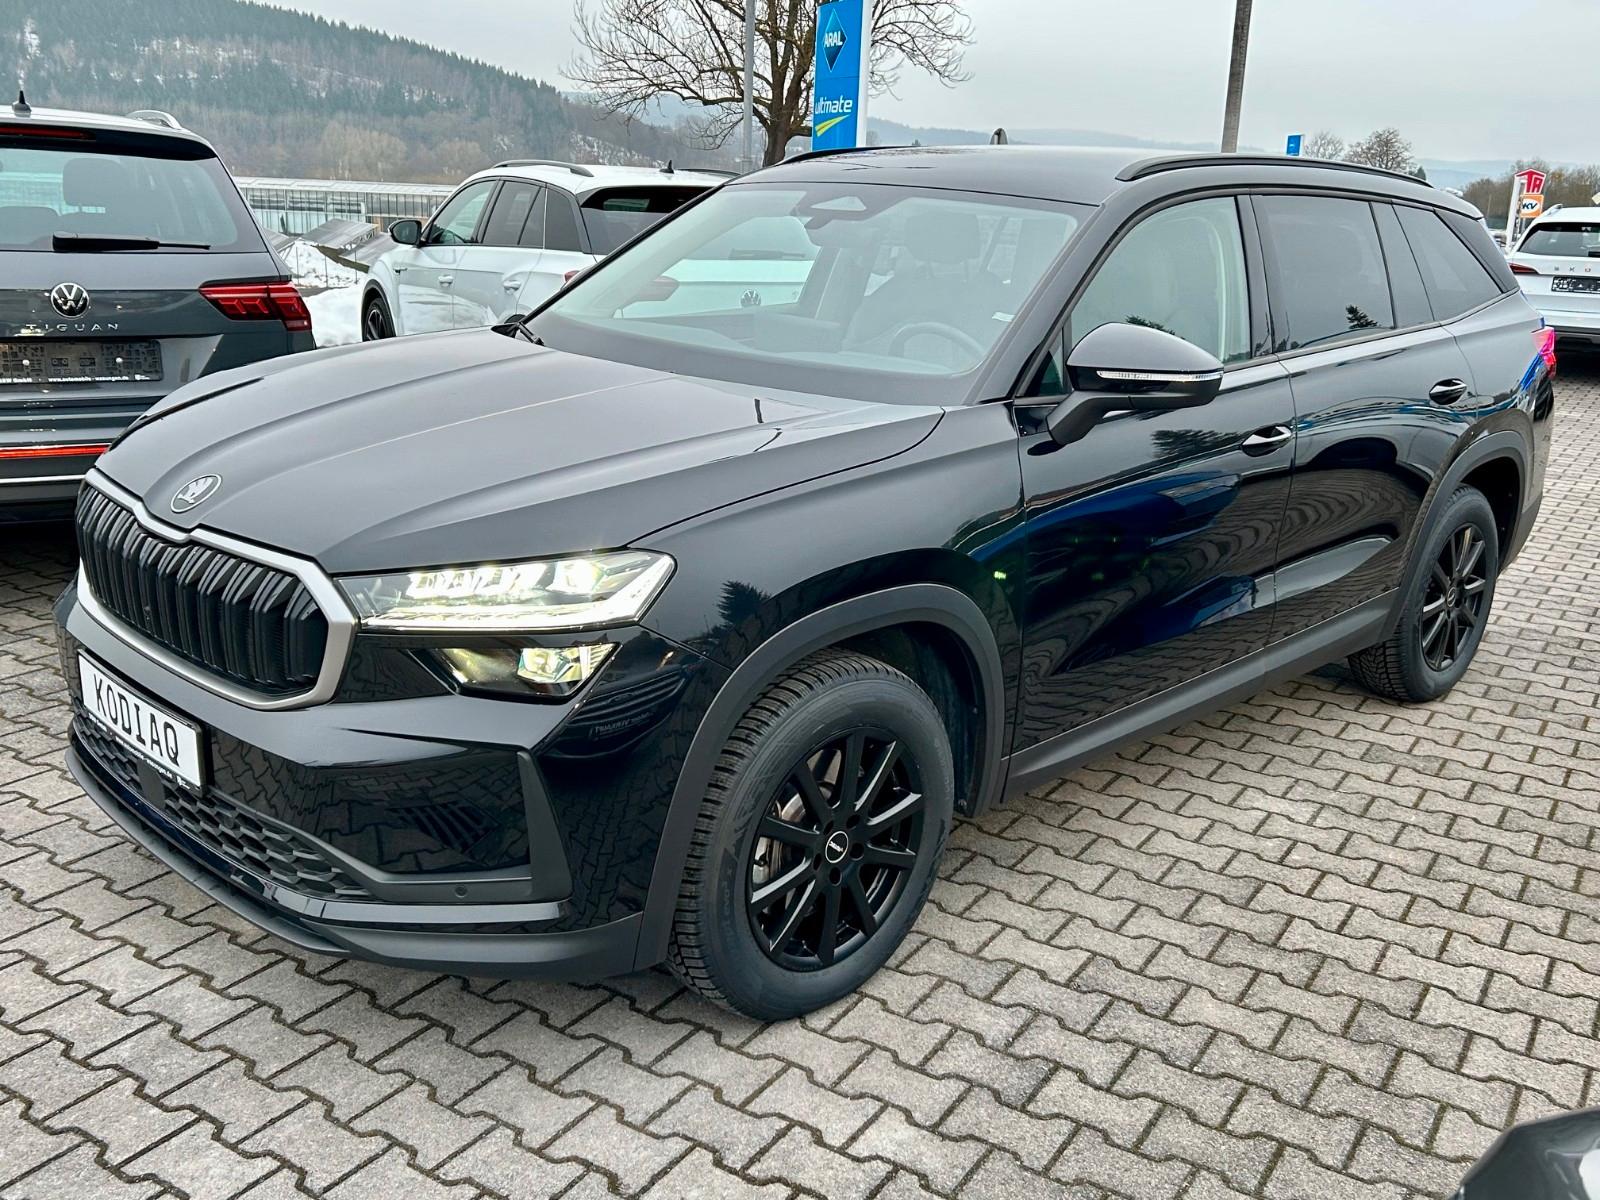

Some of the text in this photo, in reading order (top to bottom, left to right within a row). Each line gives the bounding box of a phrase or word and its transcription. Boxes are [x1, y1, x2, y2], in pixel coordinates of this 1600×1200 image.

[824, 31, 843, 48] ARAL
[815, 95, 853, 114] ultimate
[25, 323, 119, 332] TIGUAN
[93, 673, 180, 767] KODIAQ
